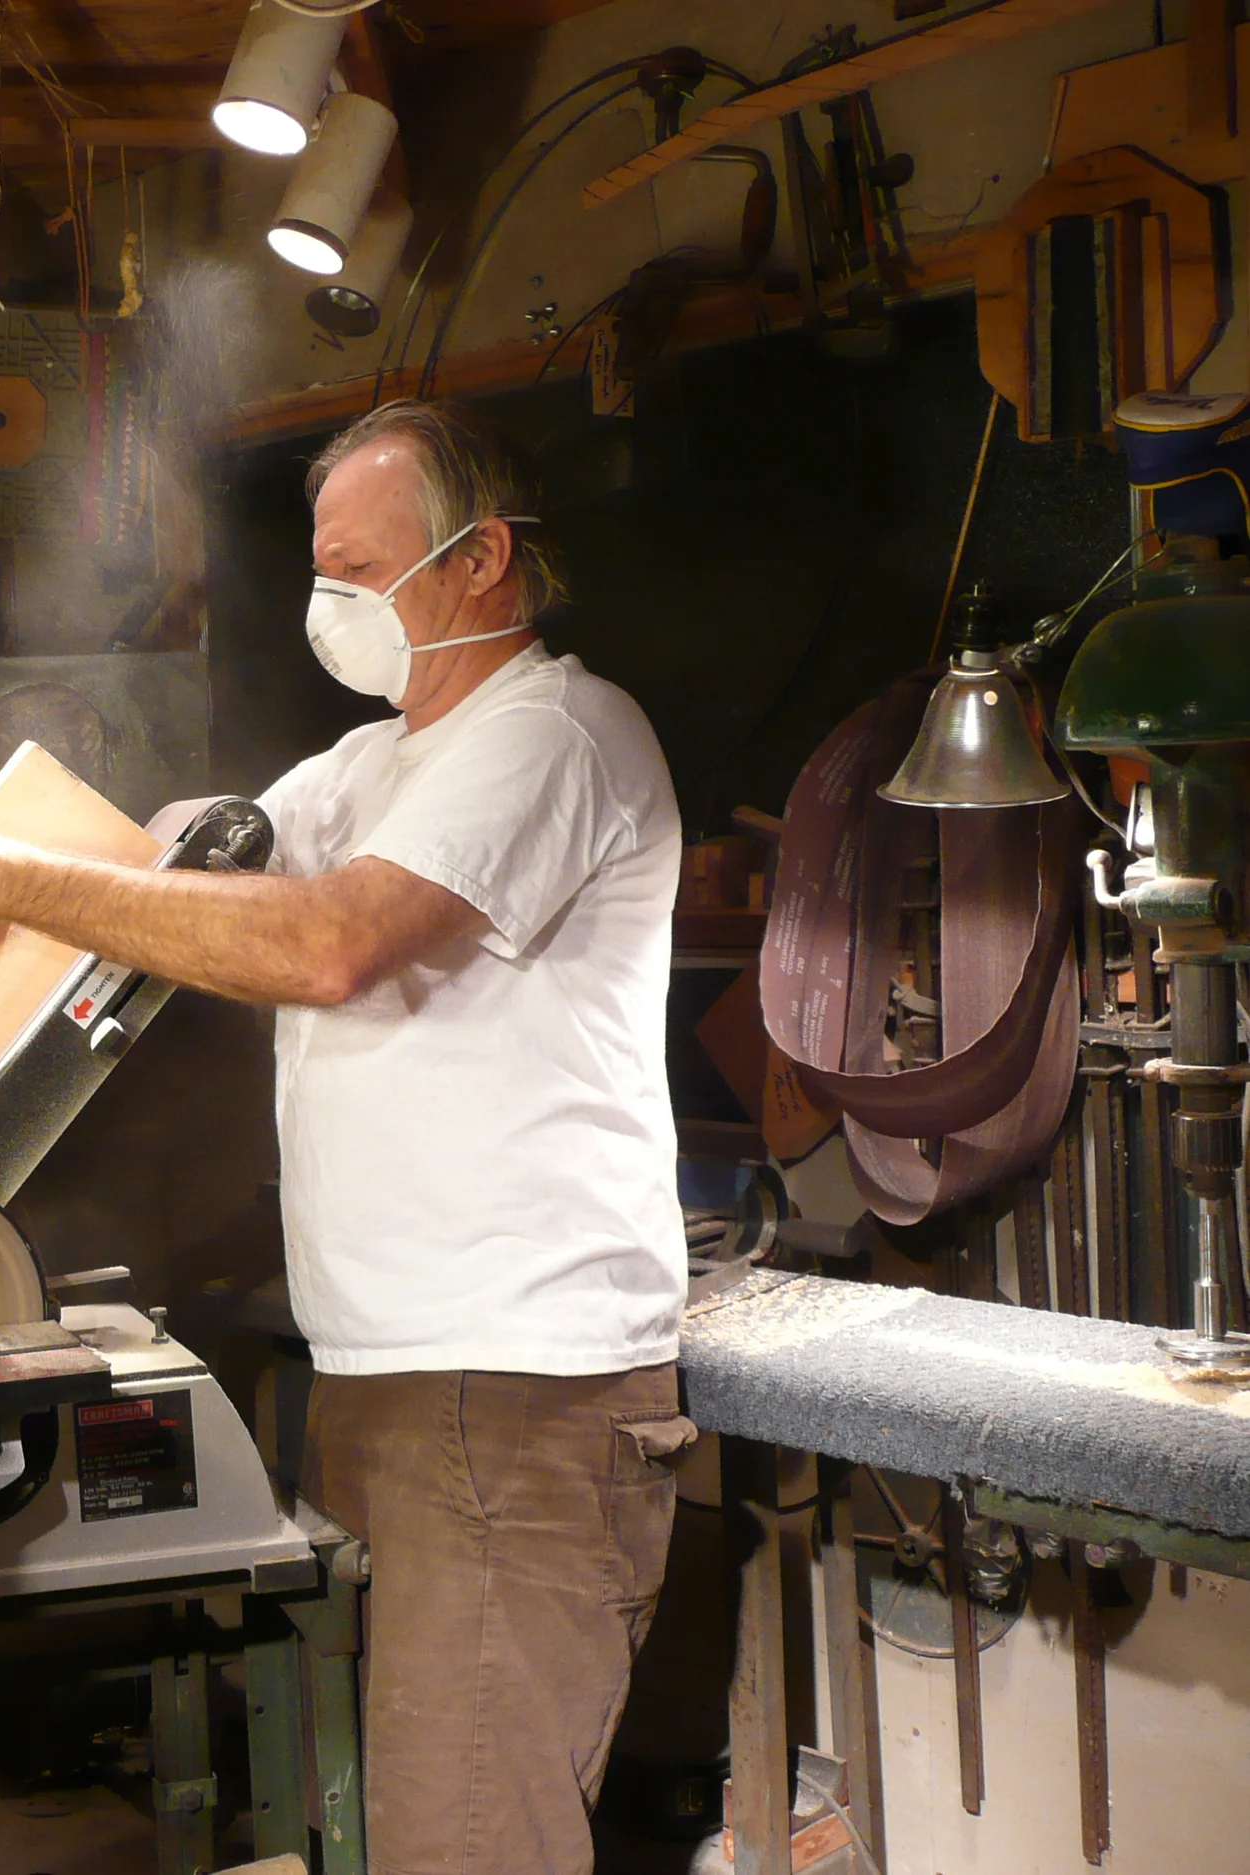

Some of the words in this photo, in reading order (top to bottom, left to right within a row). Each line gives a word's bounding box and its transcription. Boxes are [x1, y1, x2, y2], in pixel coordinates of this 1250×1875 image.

[780, 920, 793, 973] ALUMINUM
[796, 956, 805, 974] 120
[91, 971, 115, 999] TIGHTEN
[791, 1000, 799, 1017] 120
[811, 989, 821, 1018] OXIDE
[820, 993, 829, 1015] OPEN
[83, 1404, 149, 1421] CRAFTSMAN
